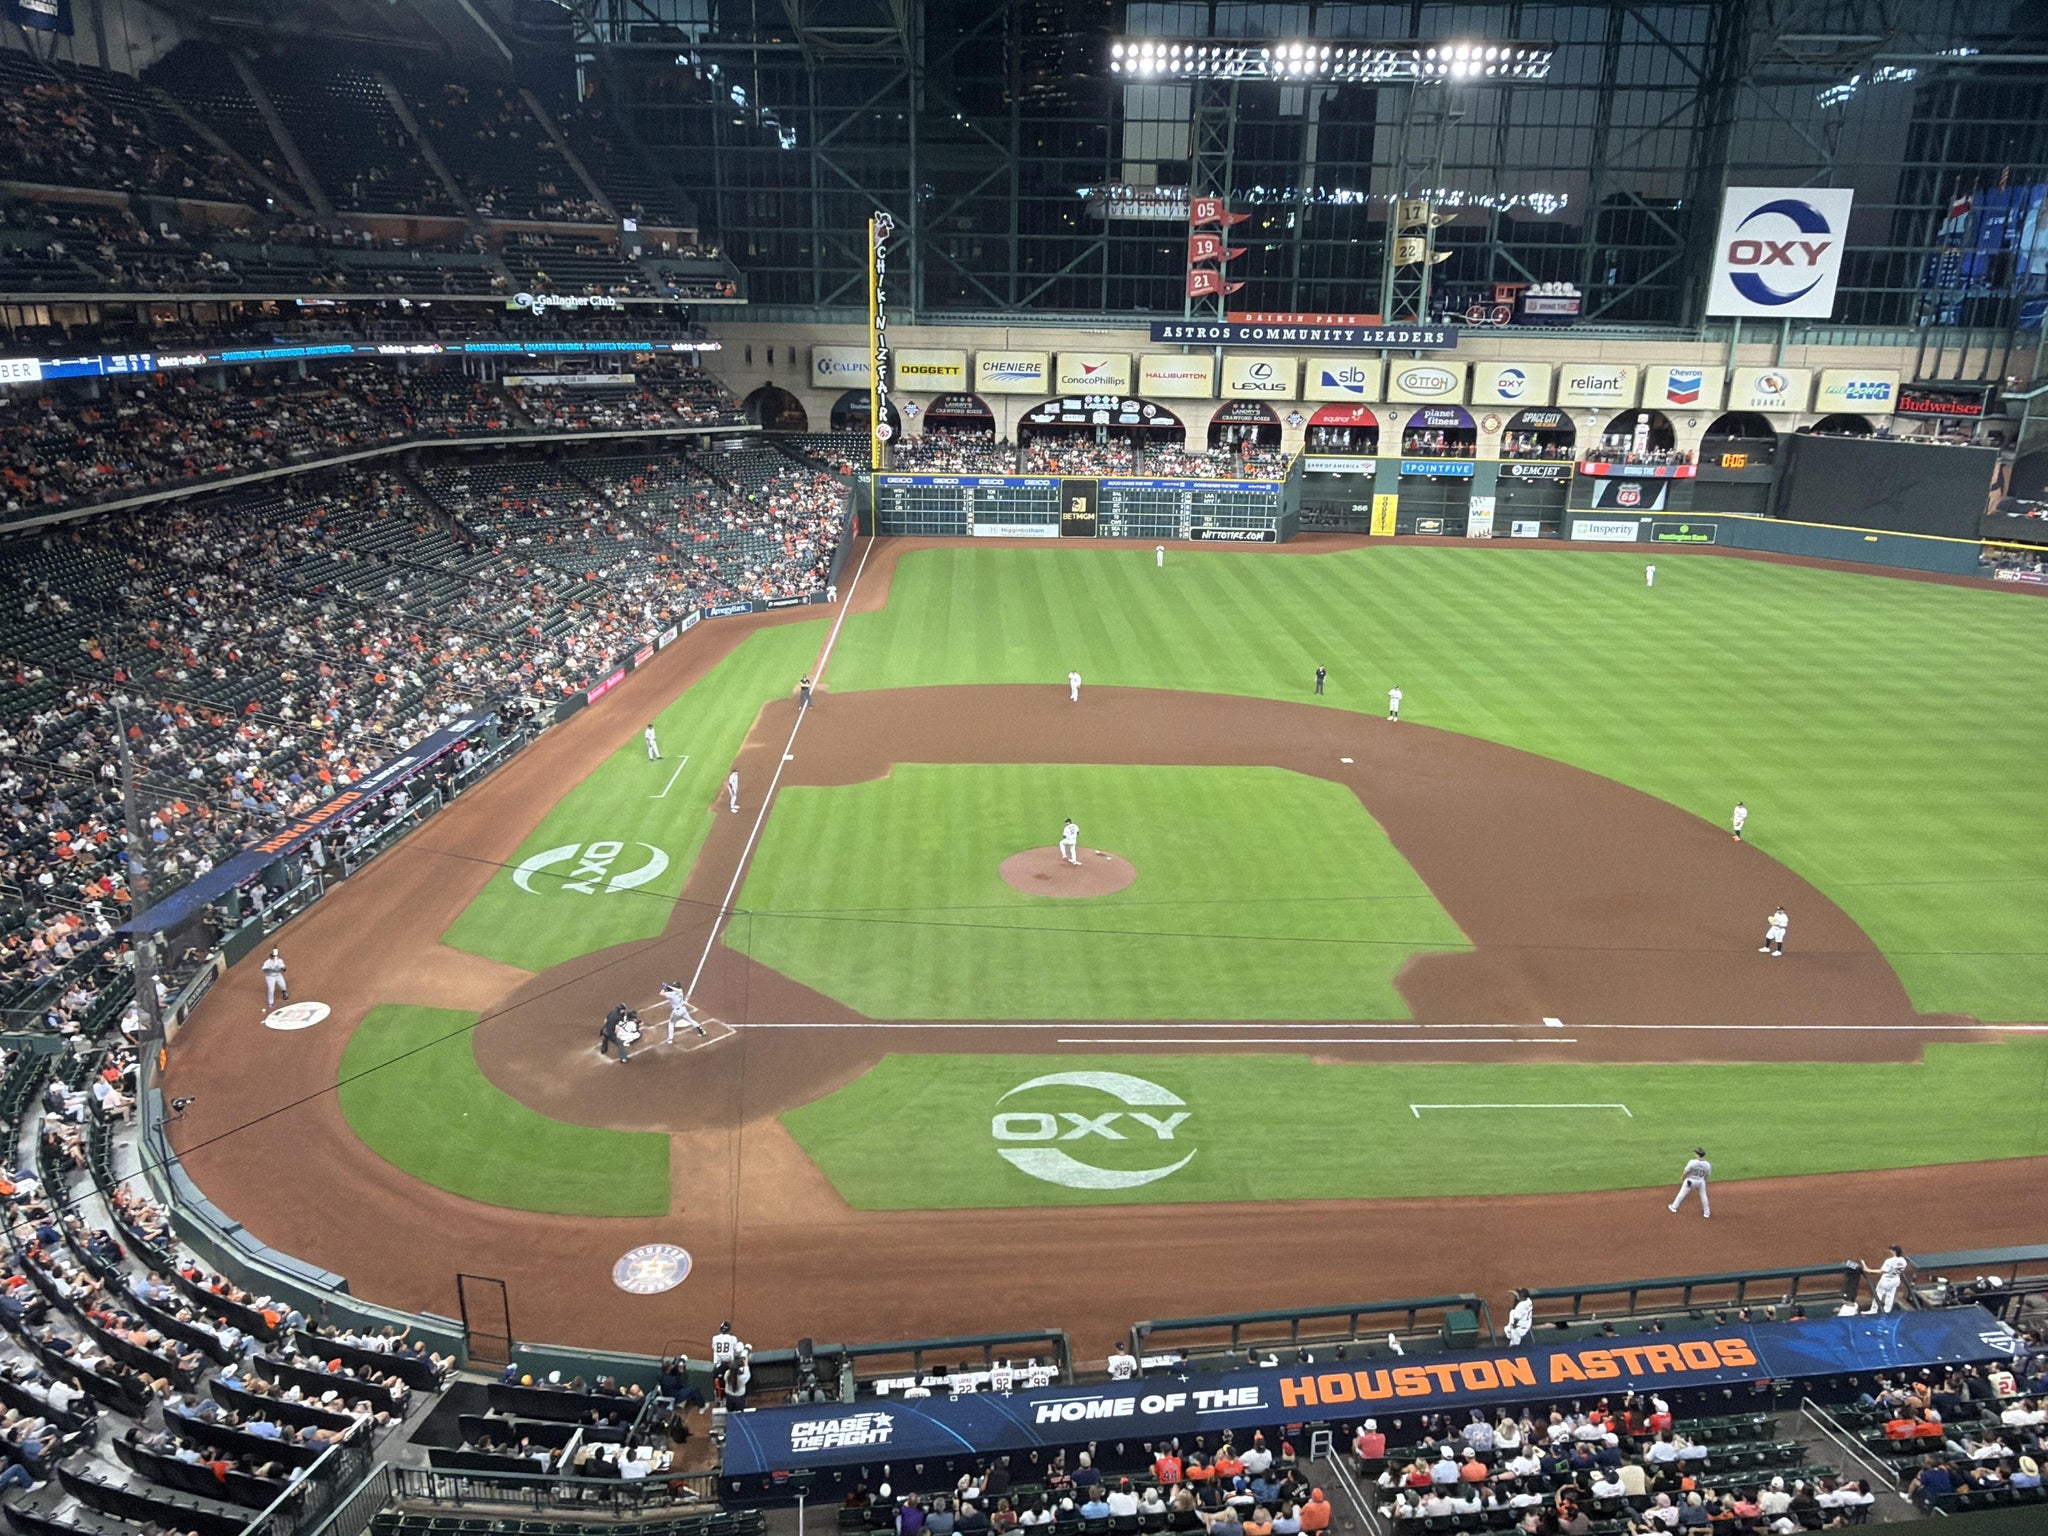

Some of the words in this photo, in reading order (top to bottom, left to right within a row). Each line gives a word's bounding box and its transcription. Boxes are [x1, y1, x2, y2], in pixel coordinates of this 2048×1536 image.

[1197, 203, 1215, 218] 05
[1404, 208, 1421, 220] 17
[1197, 241, 1213, 254] 19
[1400, 246, 1416, 258] 22
[1727, 240, 1833, 266] OXY
[1194, 274, 1210, 288] 21
[875, 246, 887, 330] CHIKIN
[537, 295, 589, 307] Gallagher
[590, 295, 616, 306] Club
[1245, 314, 1304, 323] DAIKIN
[1316, 316, 1356, 324] PARK
[1163, 326, 1231, 338] ASTROS
[1239, 328, 1355, 341] COMMUNITY
[1362, 330, 1445, 343] LEADERS
[833, 362, 871, 372] CALPIN
[901, 365, 960, 375] DOGGETT
[983, 361, 1042, 372] CHENIERE
[1146, 371, 1207, 380] HALLIBURTON
[1339, 366, 1365, 384] slb
[1669, 369, 1703, 377] Chevron
[1062, 375, 1125, 386] ConocoPhillips
[1232, 382, 1286, 391] LEXUS
[1404, 371, 1448, 390] COTTON
[1498, 380, 1523, 388] OXY
[1570, 376, 1620, 390] reliant
[875, 364, 889, 421] FAIR
[1846, 382, 1891, 399] LNG
[1750, 398, 1786, 407] QUANTA
[1898, 396, 1982, 415] Budweiser
[1424, 409, 1454, 420] planet
[1522, 412, 1545, 423] SPACE
[1545, 412, 1562, 423] CITY
[1427, 416, 1459, 426] fitness
[1405, 463, 1470, 474] 1POINTFIVE
[1522, 467, 1560, 477] EMCJET
[1620, 492, 1637, 501] 66
[1352, 504, 1368, 512] 366
[1062, 512, 1095, 520] BETMGM
[1001, 527, 1044, 535] Higginbotham
[1589, 523, 1633, 535] Insperity
[1201, 530, 1265, 541] NITTOTIRE.COM
[710, 604, 747, 617] AmegyBank
[304, 791, 364, 825] DAIKIN
[255, 823, 313, 854] PARK
[561, 841, 624, 895] OXY
[992, 1111, 1192, 1140] OXY
[627, 1246, 686, 1261] HOUSTON
[1119, 1366, 1130, 1376] 12
[996, 1378, 1009, 1390] 92
[1034, 1377, 1047, 1387] 99
[1035, 1397, 1136, 1424] HOME
[1140, 1392, 1186, 1414] OF
[1192, 1386, 1259, 1409] THE
[1279, 1356, 1537, 1408] HOUSTON
[1549, 1337, 1758, 1383] ASTROS
[958, 1384, 973, 1394] 22
[791, 1415, 872, 1438] CHASE
[791, 1436, 824, 1449] THE
[824, 1427, 893, 1448] FIGHT
[1163, 1470, 1179, 1482] 44
